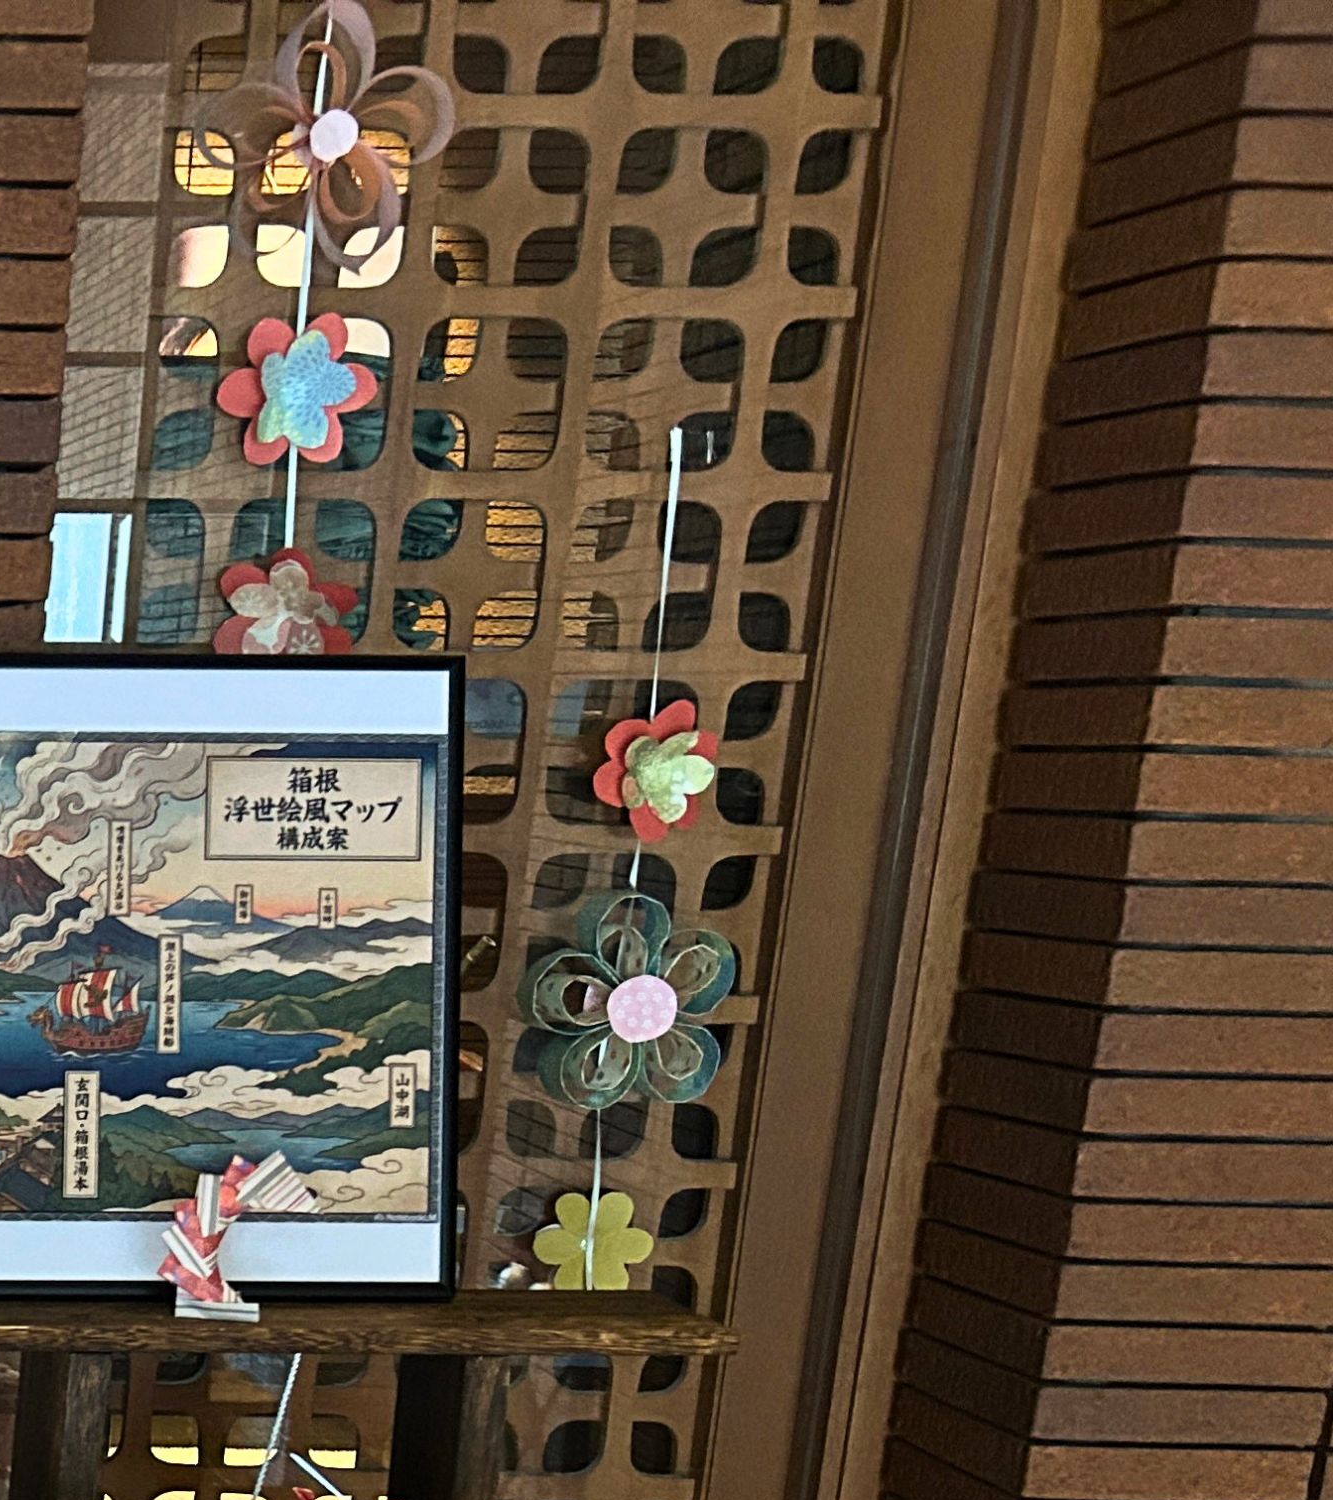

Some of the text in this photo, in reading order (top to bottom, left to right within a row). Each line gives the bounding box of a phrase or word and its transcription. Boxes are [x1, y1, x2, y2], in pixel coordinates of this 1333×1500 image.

[287, 766, 341, 794] 箱根
[224, 796, 403, 823] 浮世絵風マップ
[276, 826, 350, 851] 構成案
[394, 1072, 410, 1119] 山中湖
[73, 1078, 90, 1193] 玄関口・箱根湯本
